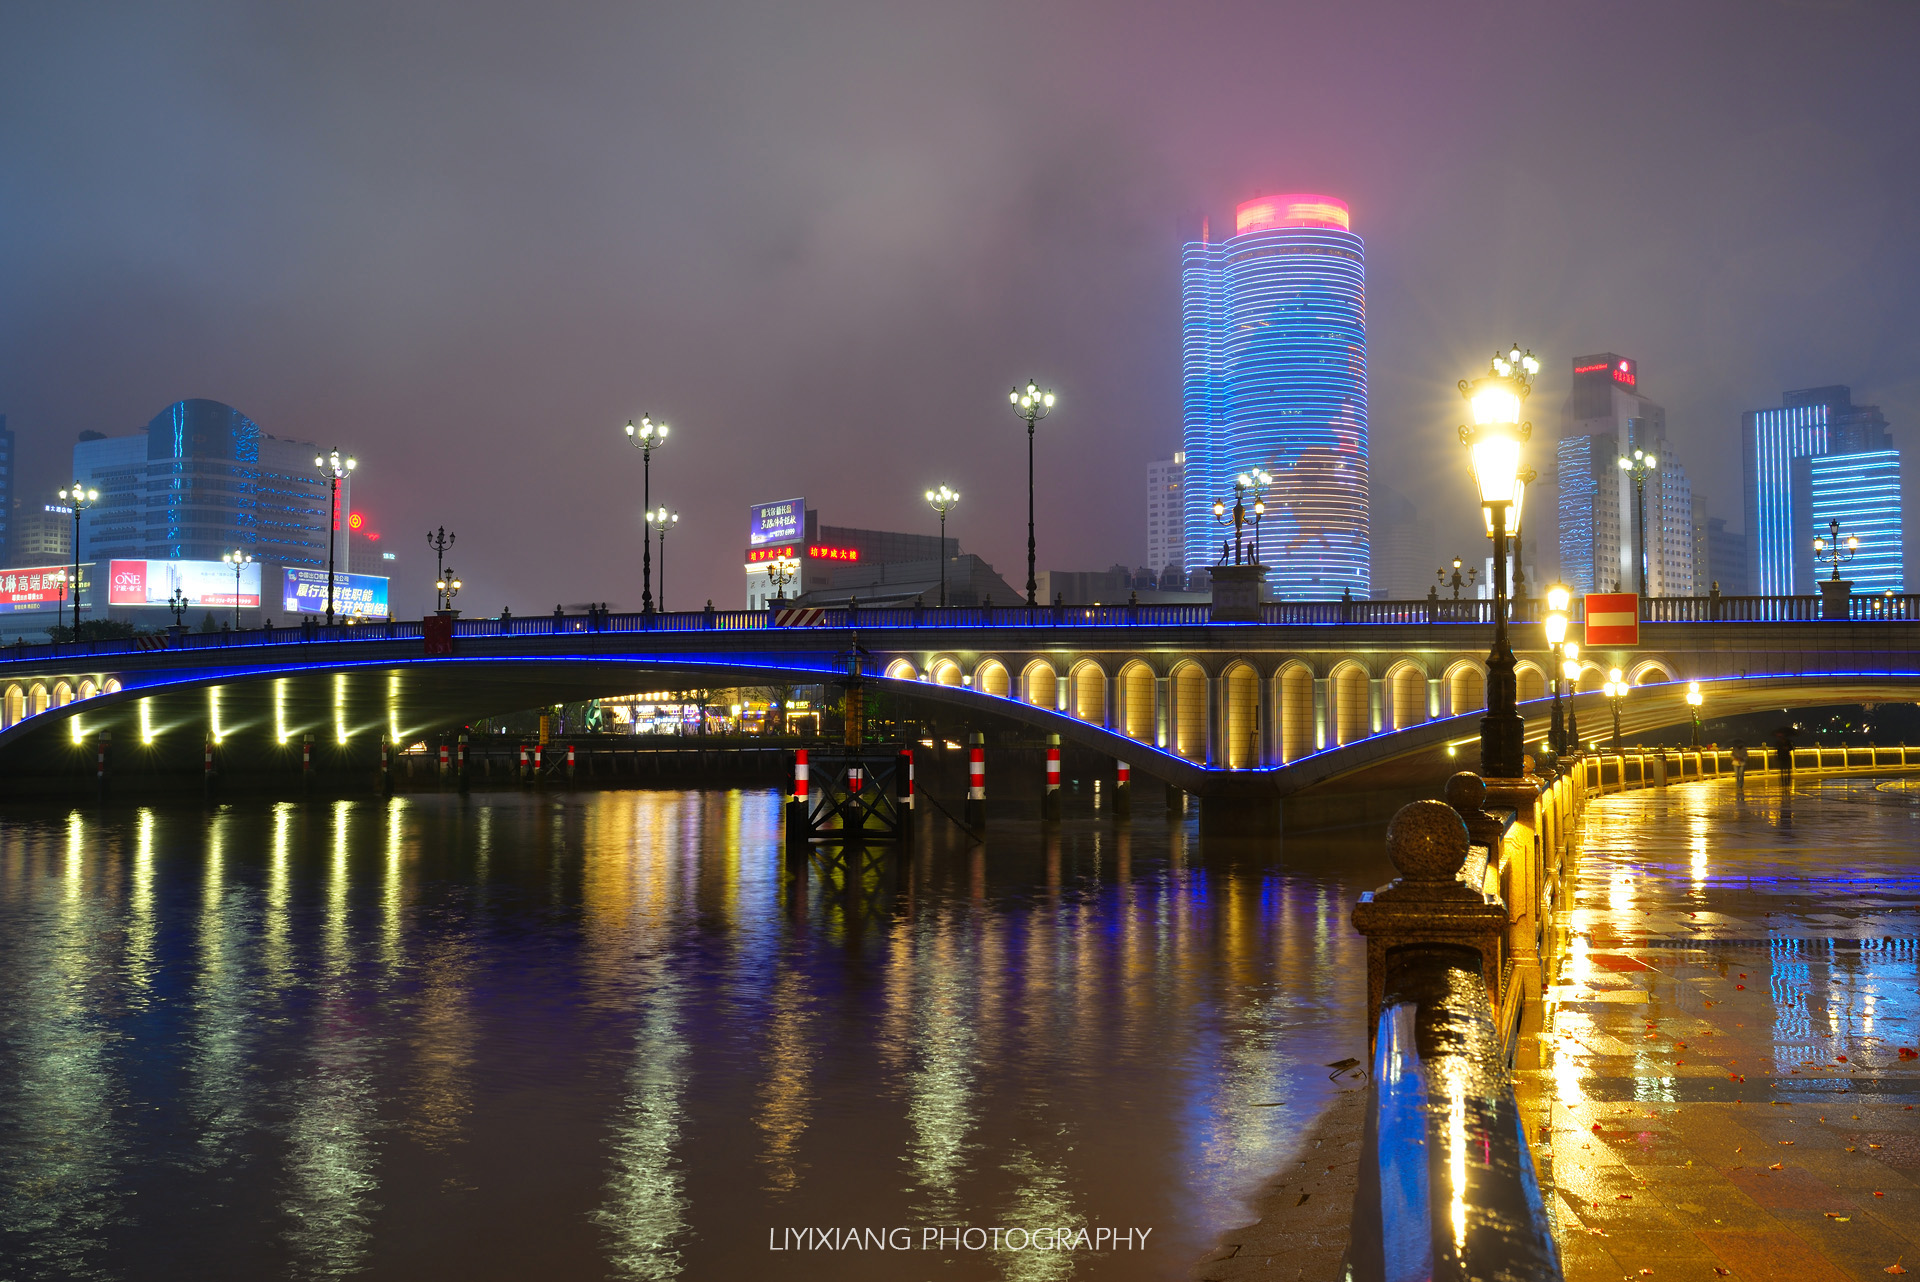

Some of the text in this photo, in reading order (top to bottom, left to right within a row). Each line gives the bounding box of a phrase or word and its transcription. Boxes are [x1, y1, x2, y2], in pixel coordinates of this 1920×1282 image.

[810, 547, 857, 561] 培罗成大楼
[115, 575, 141, 584] ONE
[296, 583, 373, 602] 履行政策性职能
